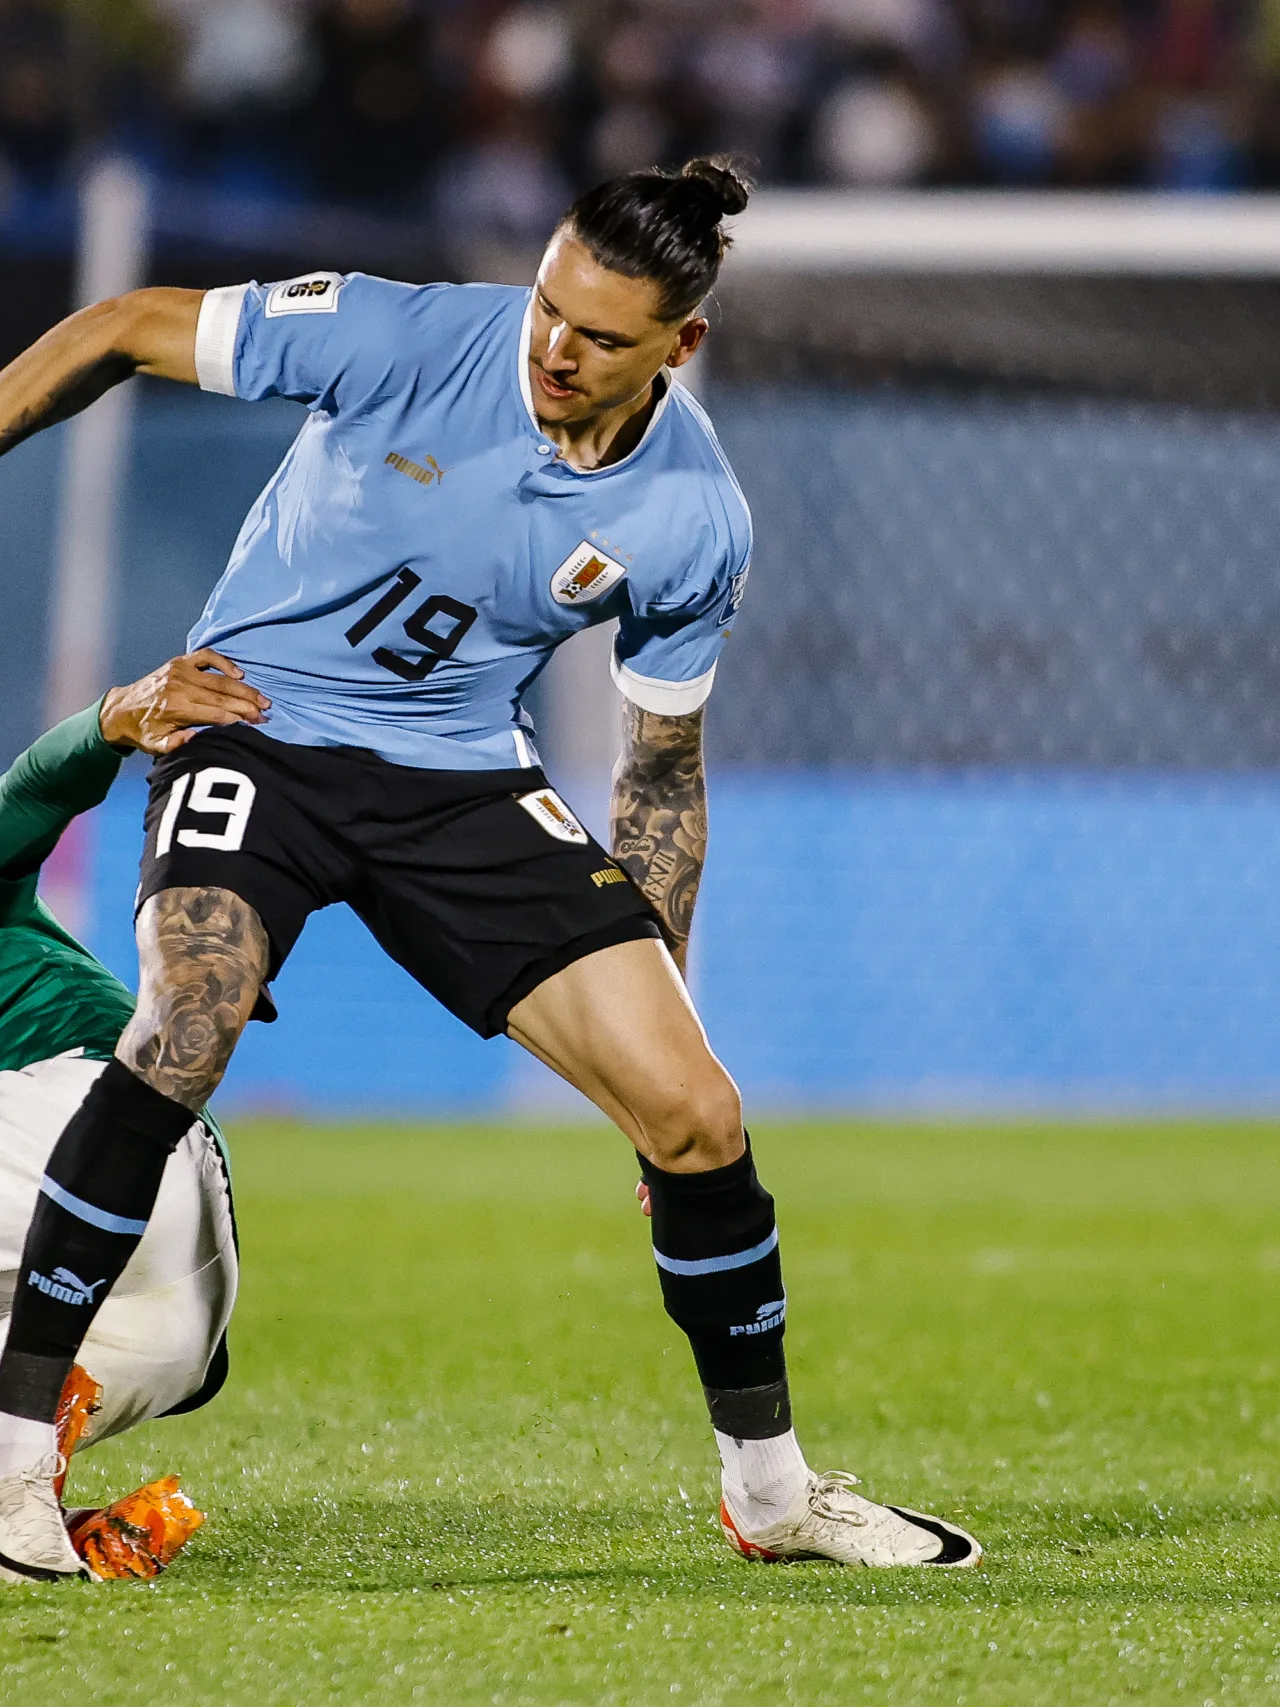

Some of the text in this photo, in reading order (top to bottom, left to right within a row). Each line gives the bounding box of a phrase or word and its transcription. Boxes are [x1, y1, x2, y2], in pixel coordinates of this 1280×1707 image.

[384, 452, 434, 486] PUMA
[344, 566, 478, 682] 19
[155, 766, 257, 859] 19
[590, 868, 628, 888] PUM
[27, 1270, 85, 1306] PUMA
